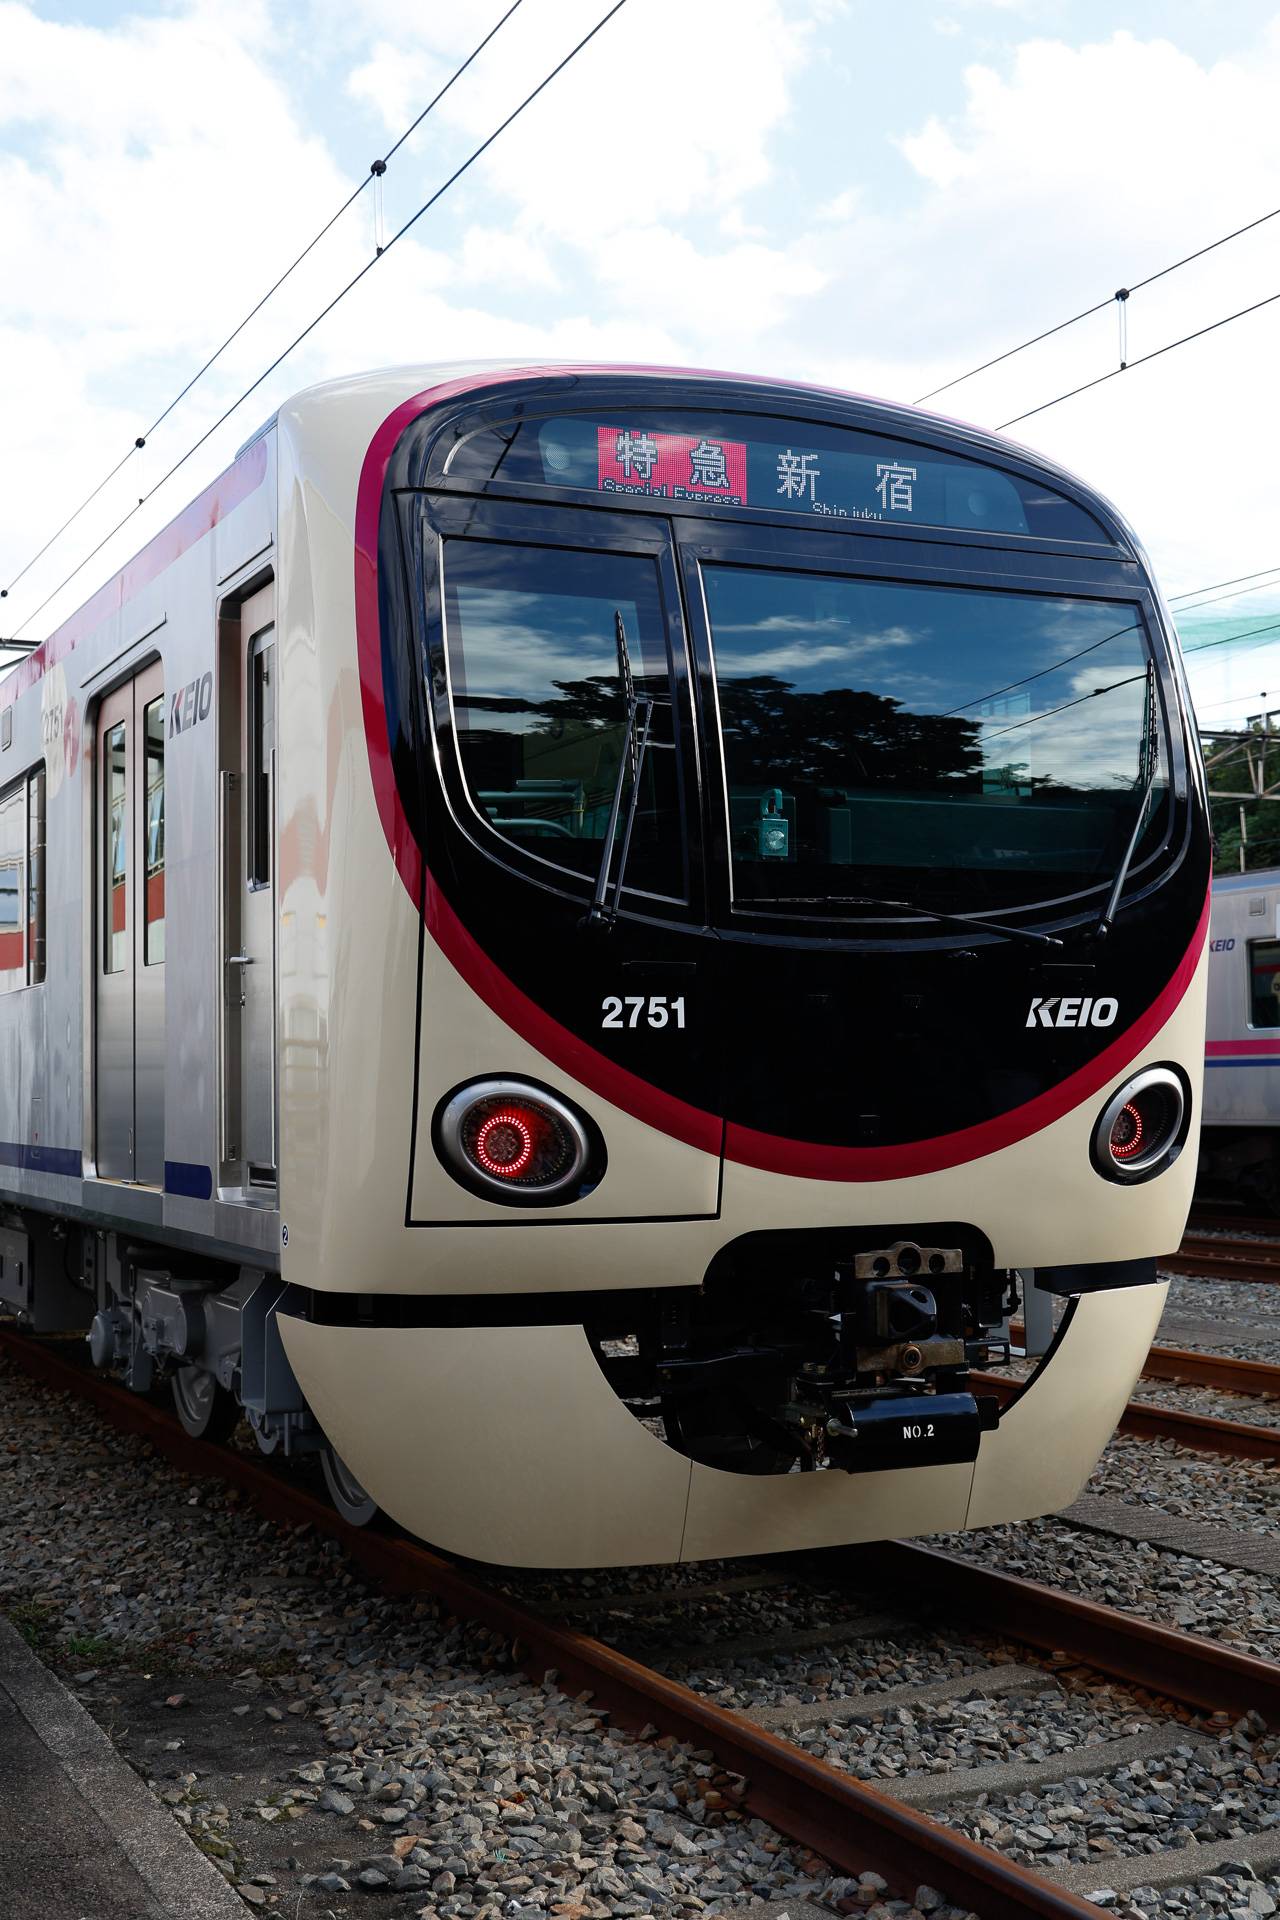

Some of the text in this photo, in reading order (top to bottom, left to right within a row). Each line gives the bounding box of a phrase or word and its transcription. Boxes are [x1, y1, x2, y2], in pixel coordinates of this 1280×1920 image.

[617, 432, 729, 487] 特急
[776, 449, 917, 512] 新宿
[44, 701, 63, 745] 2751
[169, 671, 213, 740] KEIO
[601, 996, 685, 1028] 2751
[1025, 997, 1119, 1027] KEIO
